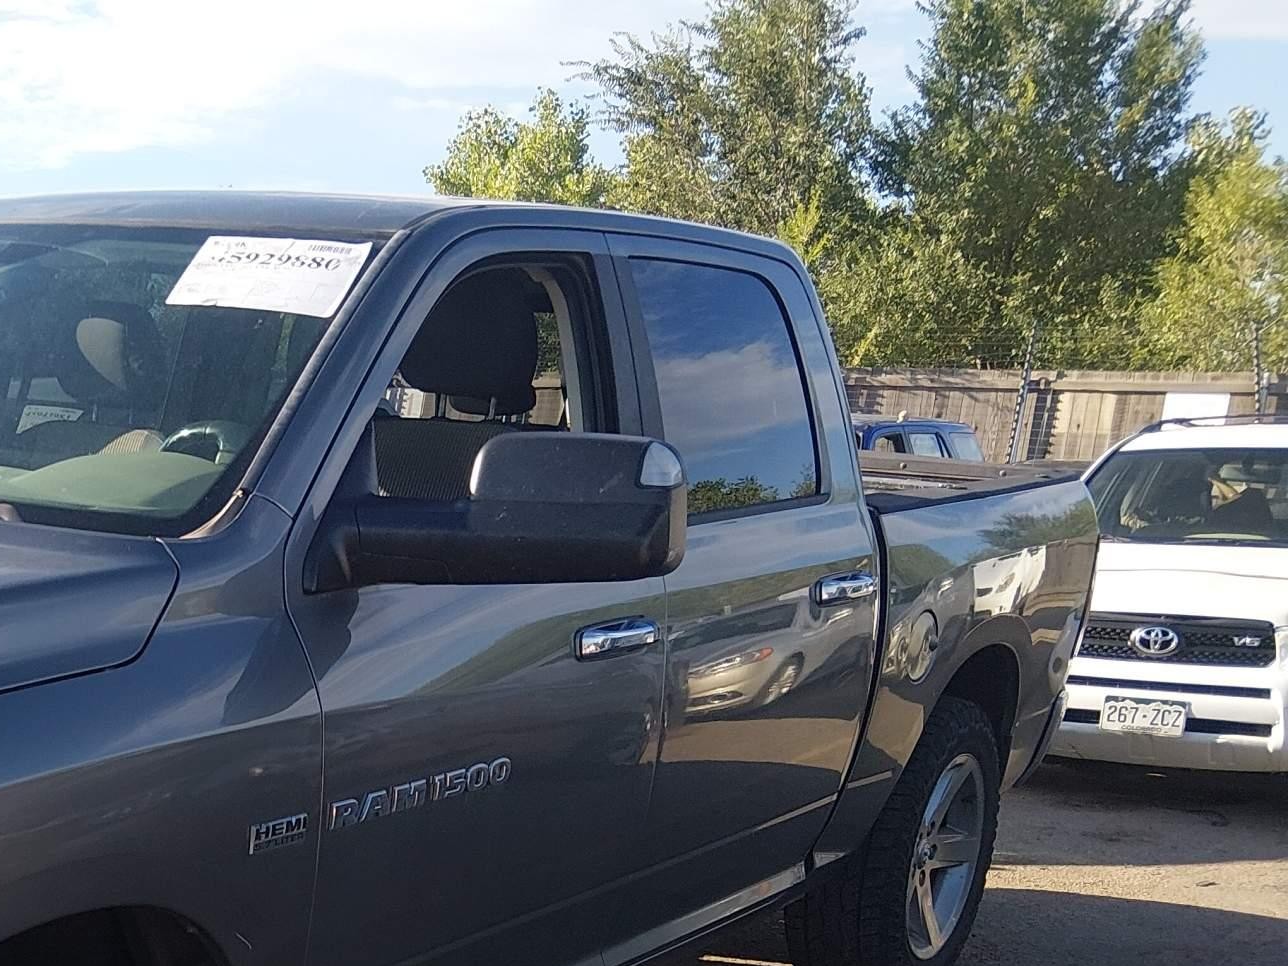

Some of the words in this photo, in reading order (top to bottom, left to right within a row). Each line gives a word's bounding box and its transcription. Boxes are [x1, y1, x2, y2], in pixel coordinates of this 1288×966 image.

[1231, 635, 1263, 648] V6
[327, 778, 428, 831] RAM
[430, 756, 513, 802] 1500
[254, 814, 308, 842] HEMI
